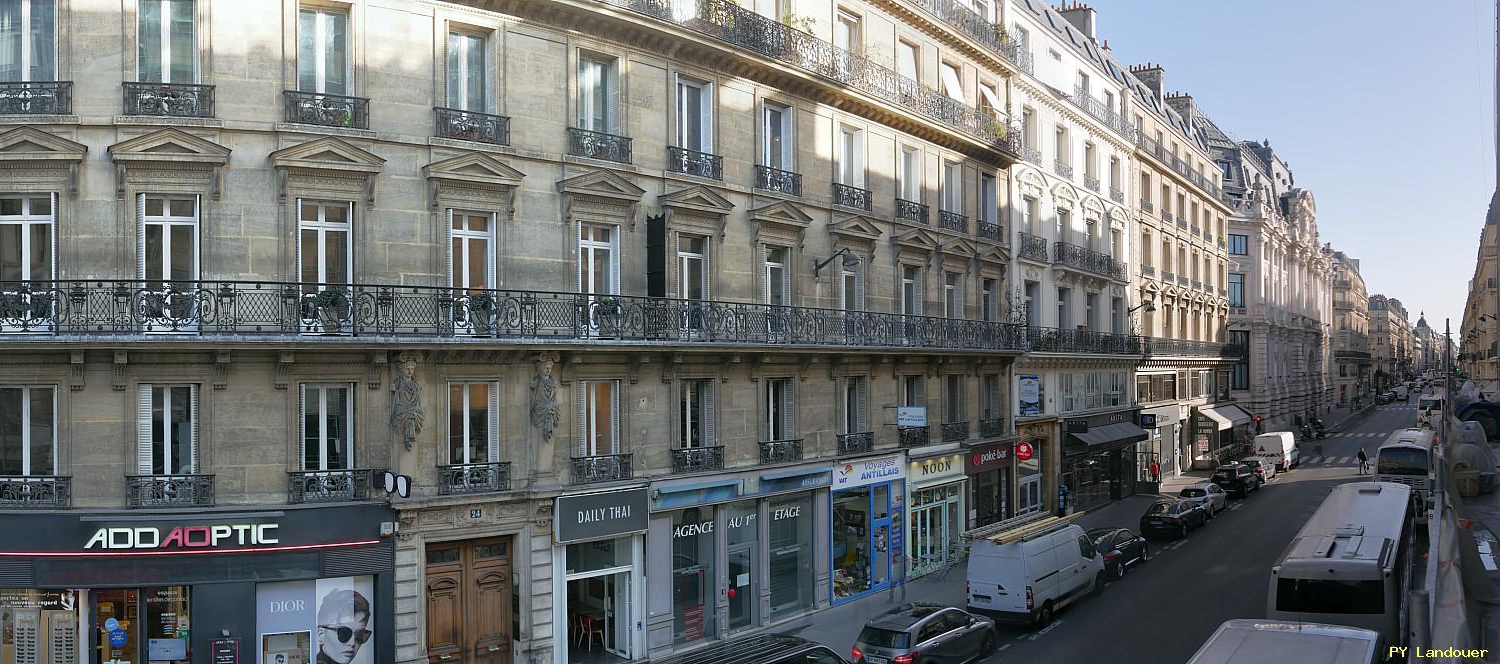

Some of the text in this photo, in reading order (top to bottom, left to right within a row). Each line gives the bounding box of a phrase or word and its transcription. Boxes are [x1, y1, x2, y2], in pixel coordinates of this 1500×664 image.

[996, 449, 1007, 459] bar
[864, 459, 895, 471] Voyages
[922, 460, 951, 476] NOON
[860, 467, 900, 480] ANTILLAIS
[578, 505, 631, 524] DAILY THAI
[673, 521, 714, 538] AGENCE
[728, 516, 743, 528] AU
[774, 506, 801, 520] ETAGE
[269, 600, 306, 613] DIOR
